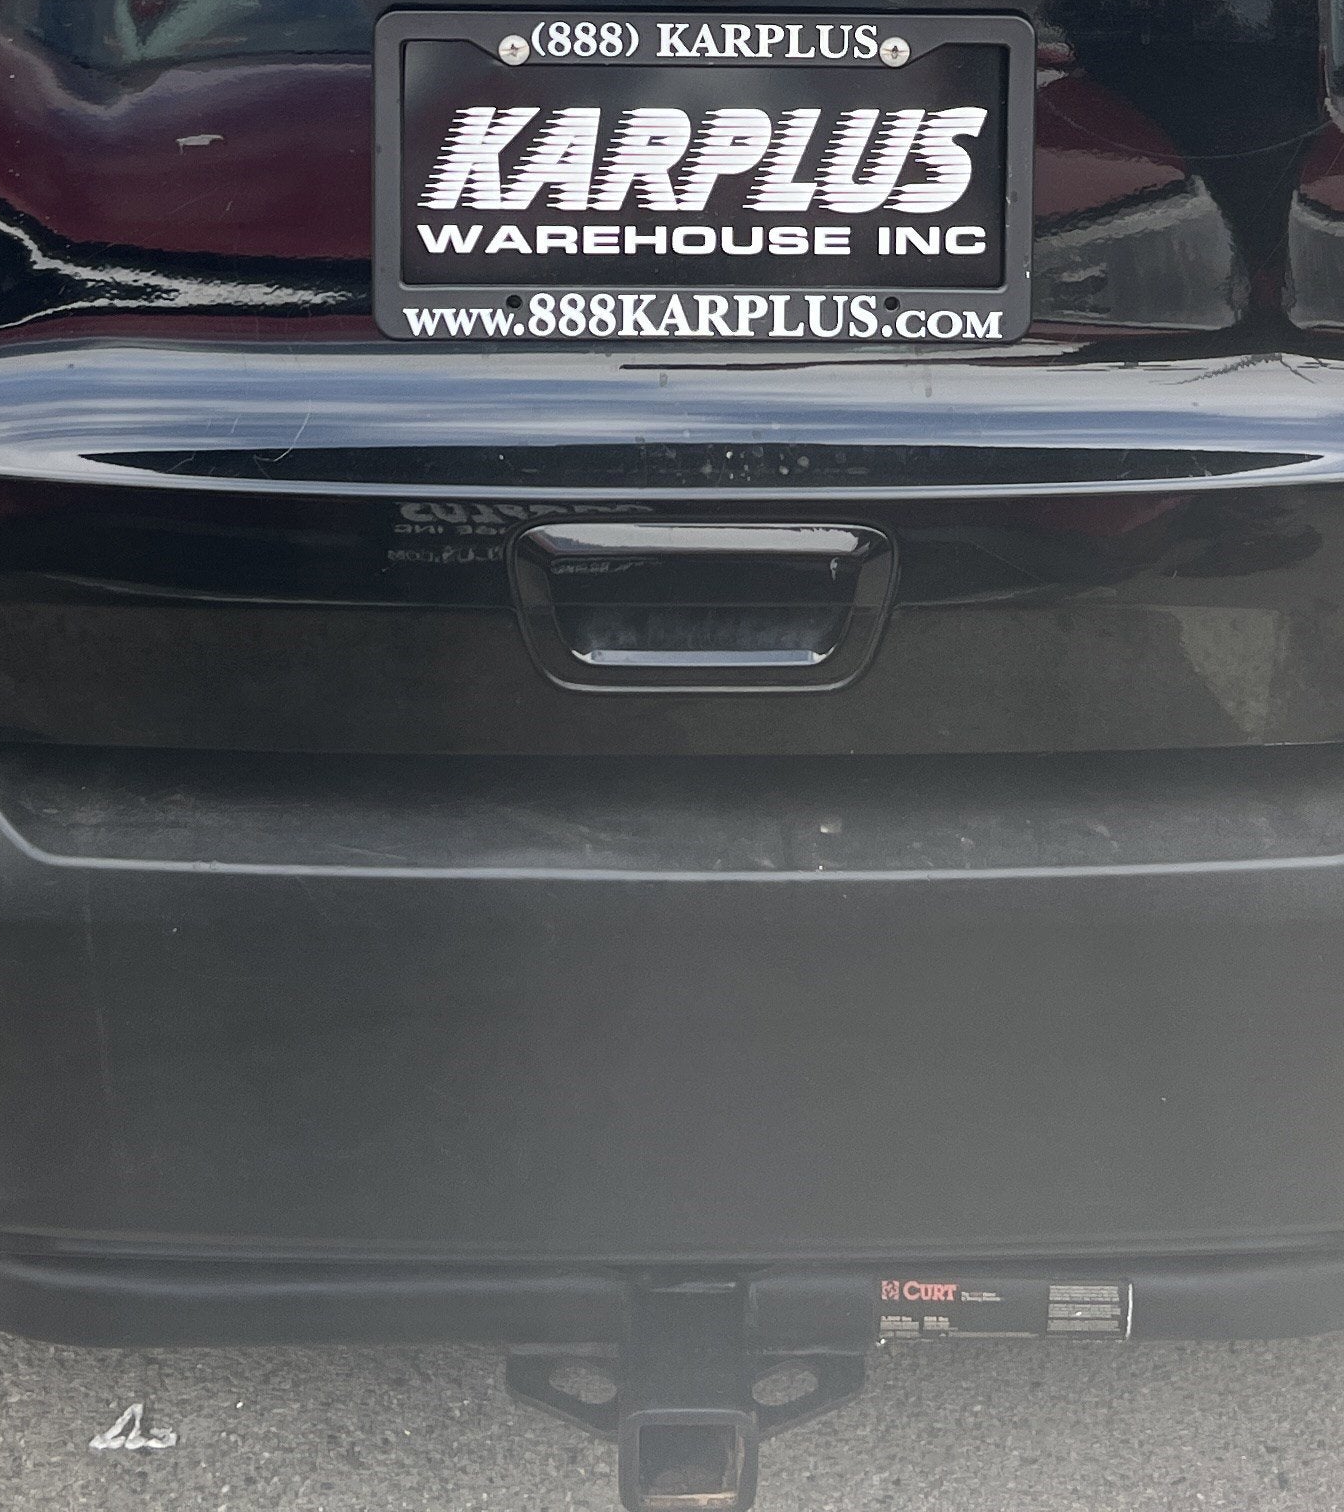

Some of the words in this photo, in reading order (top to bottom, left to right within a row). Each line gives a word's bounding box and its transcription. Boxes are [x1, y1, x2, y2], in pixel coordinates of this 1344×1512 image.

[530, 21, 640, 58] (888)
[655, 22, 880, 60] KARPLUS
[416, 105, 989, 214] KARPLUS
[416, 224, 852, 256] WAREHOUSE
[877, 225, 987, 256] INC
